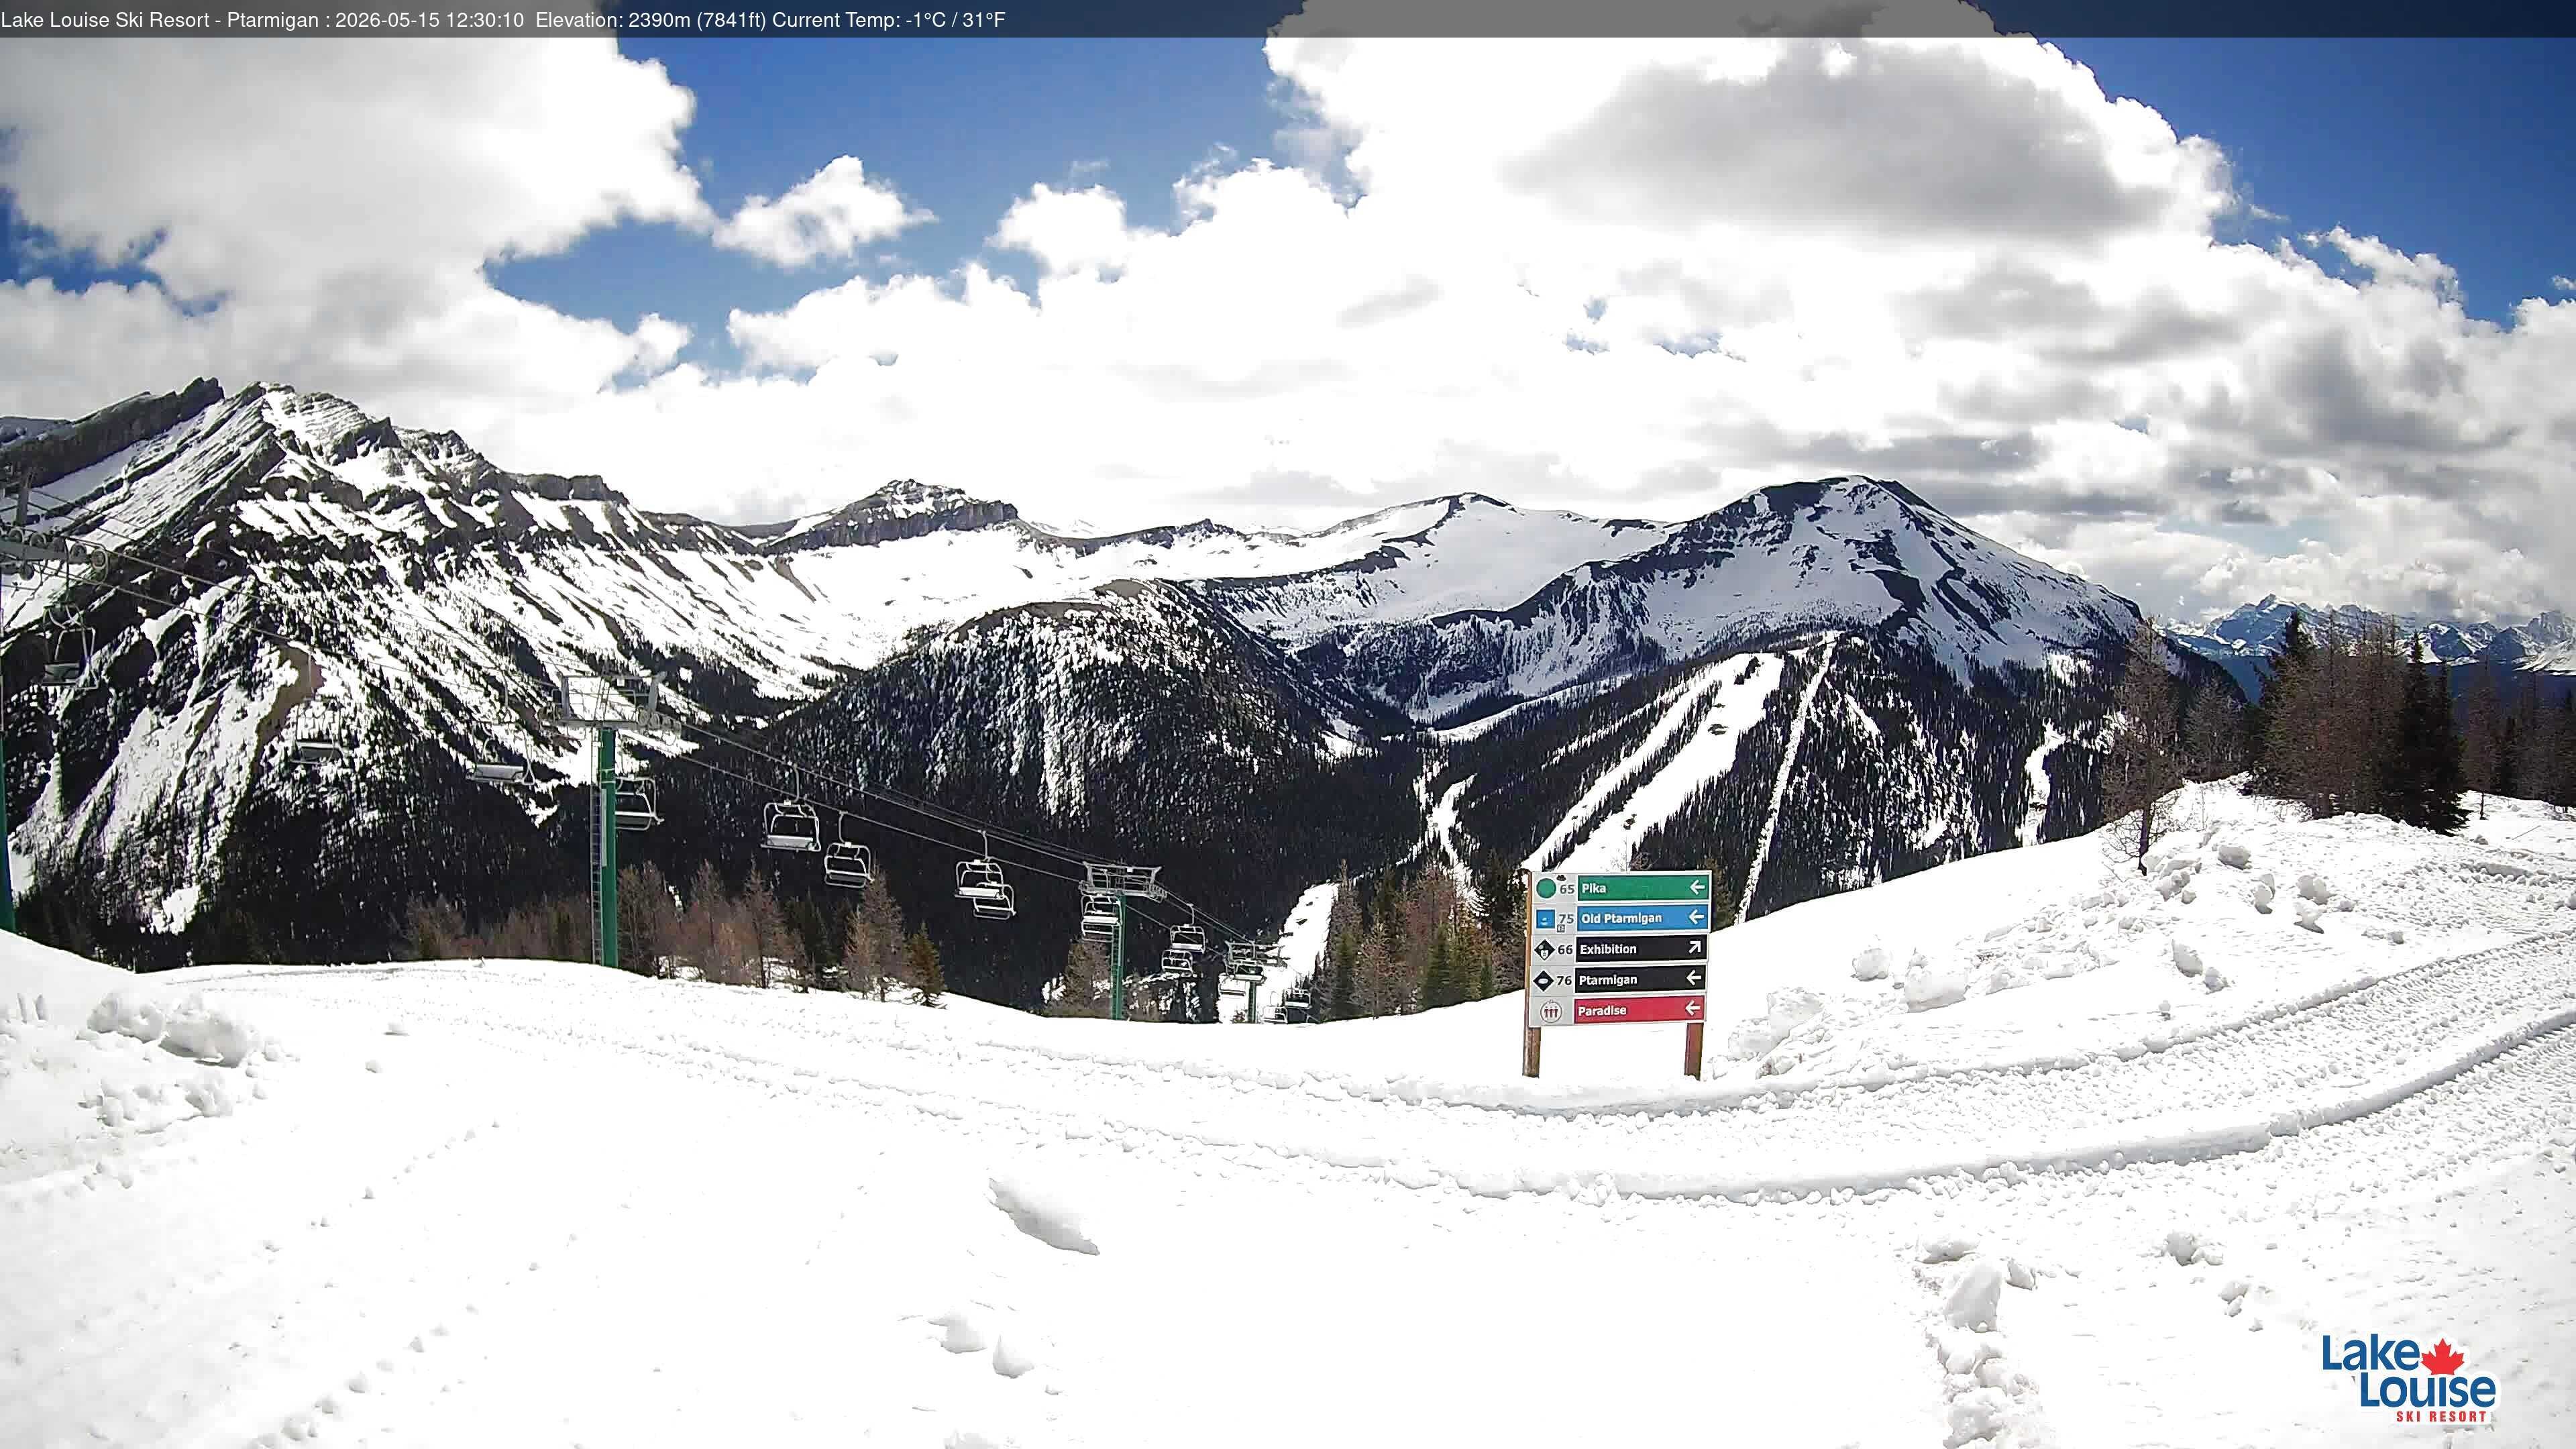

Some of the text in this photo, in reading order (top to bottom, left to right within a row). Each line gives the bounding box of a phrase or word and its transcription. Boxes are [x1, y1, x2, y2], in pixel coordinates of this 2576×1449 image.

[1560, 883, 1607, 894] 65 Pika
[1558, 912, 1662, 924] 75 Old Ptarmigan
[1558, 944, 1637, 955] 66 Exhibition
[1556, 974, 1638, 987] 76 Ptarmigan
[1578, 1005, 1627, 1016] Paradise
